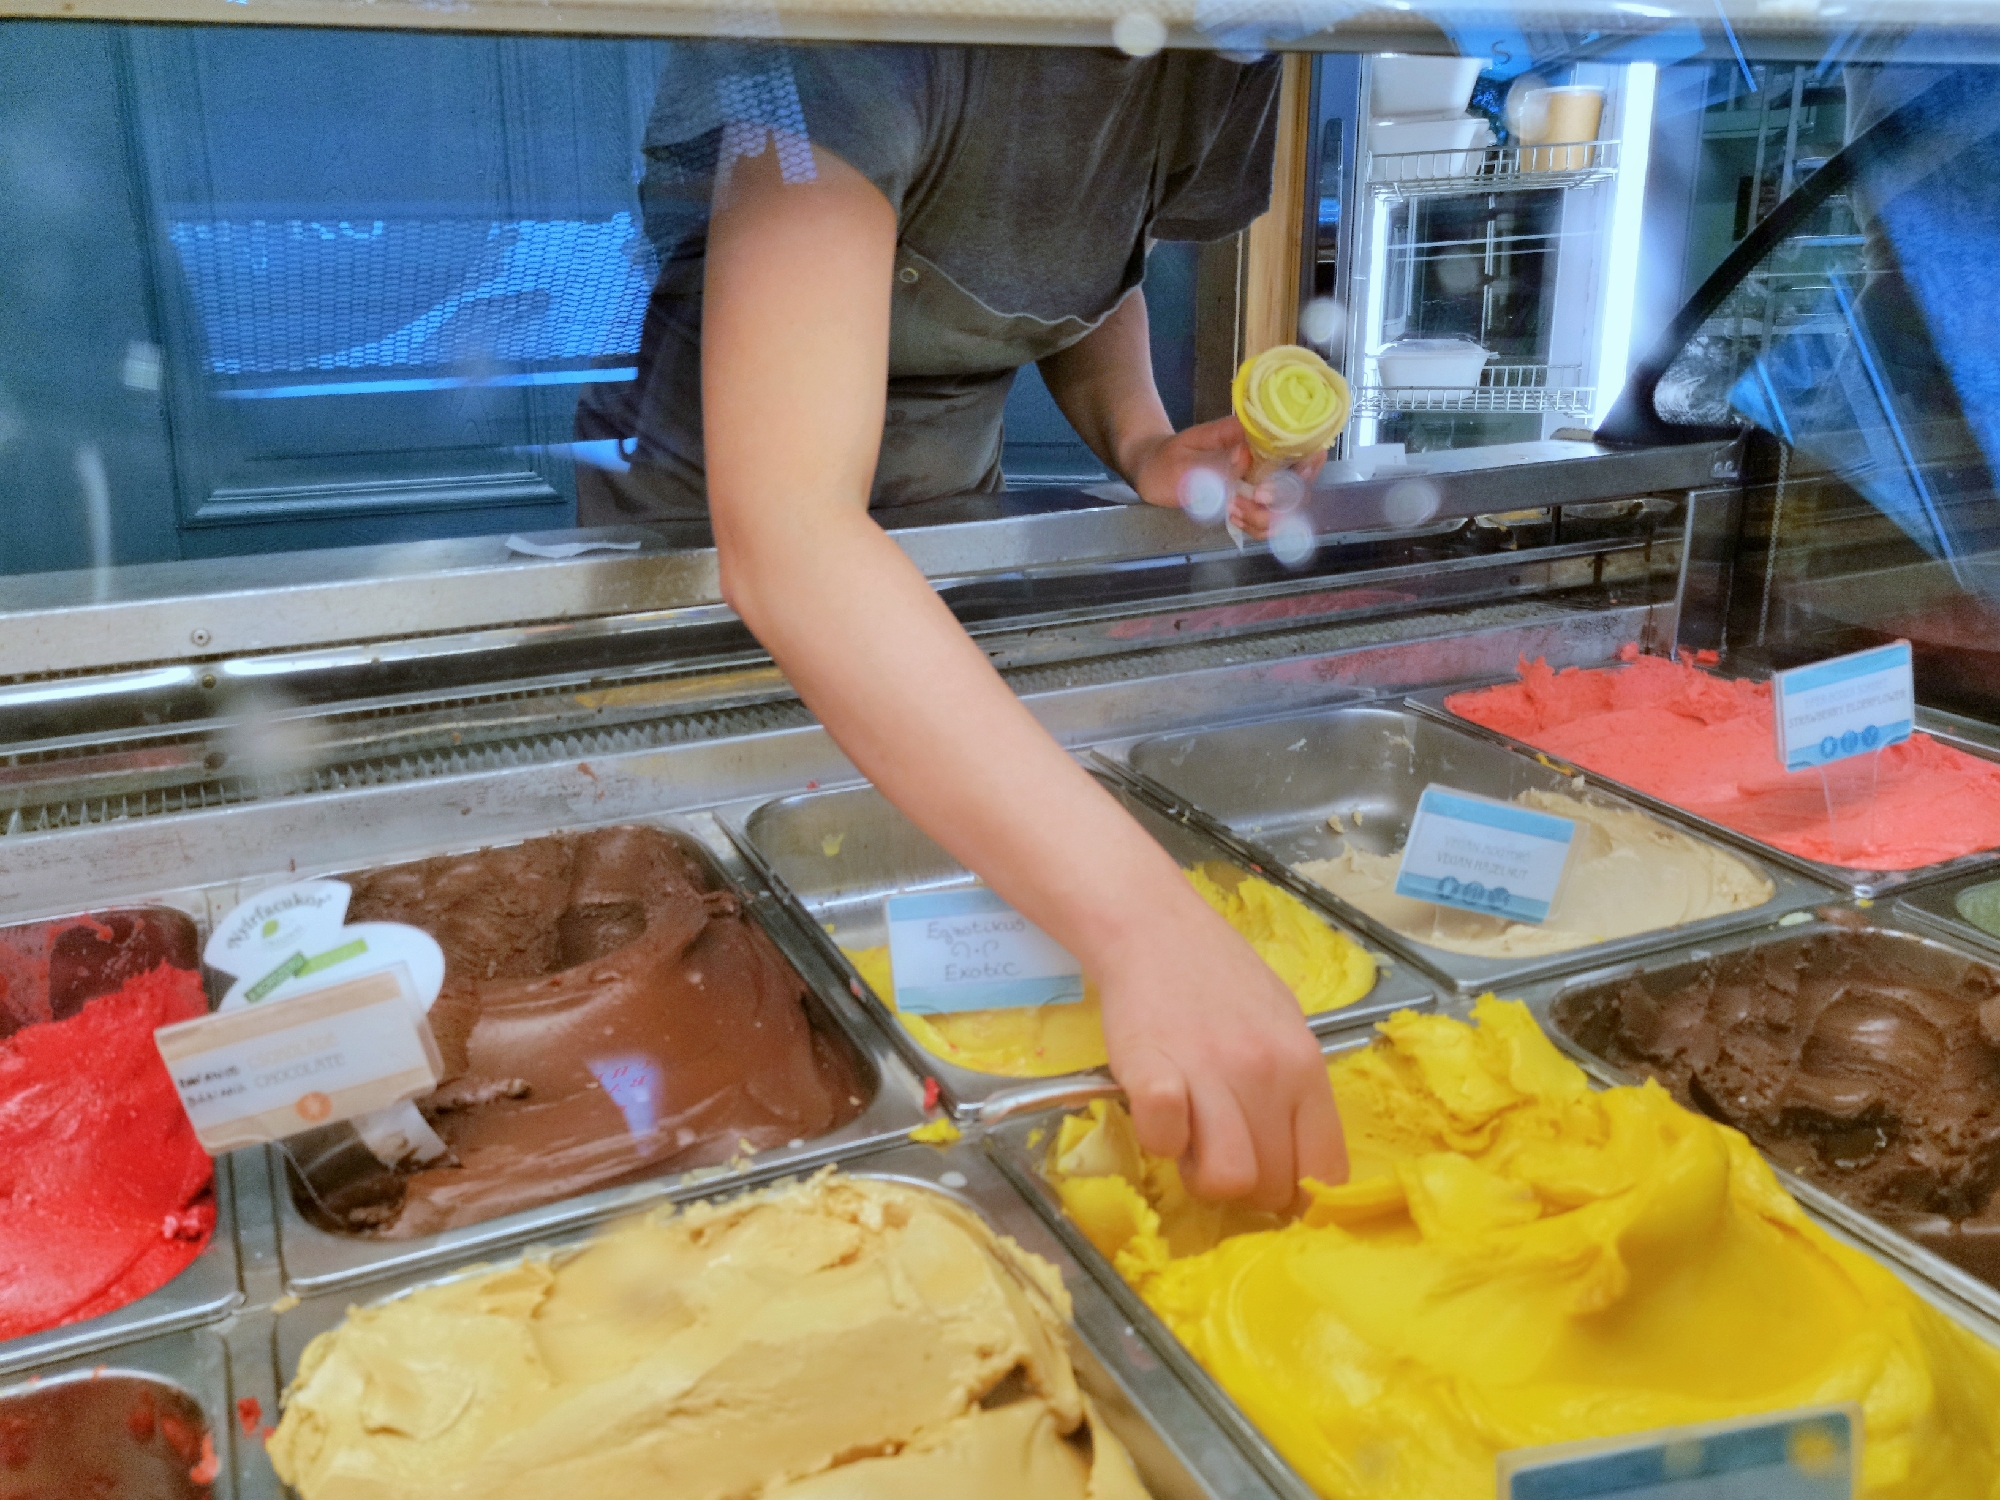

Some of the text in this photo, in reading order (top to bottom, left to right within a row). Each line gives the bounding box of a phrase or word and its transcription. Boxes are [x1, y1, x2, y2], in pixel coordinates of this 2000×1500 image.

[1436, 851, 1529, 880] VEGAN HAZELNUT
[254, 1052, 346, 1089] CHOCOLATE
